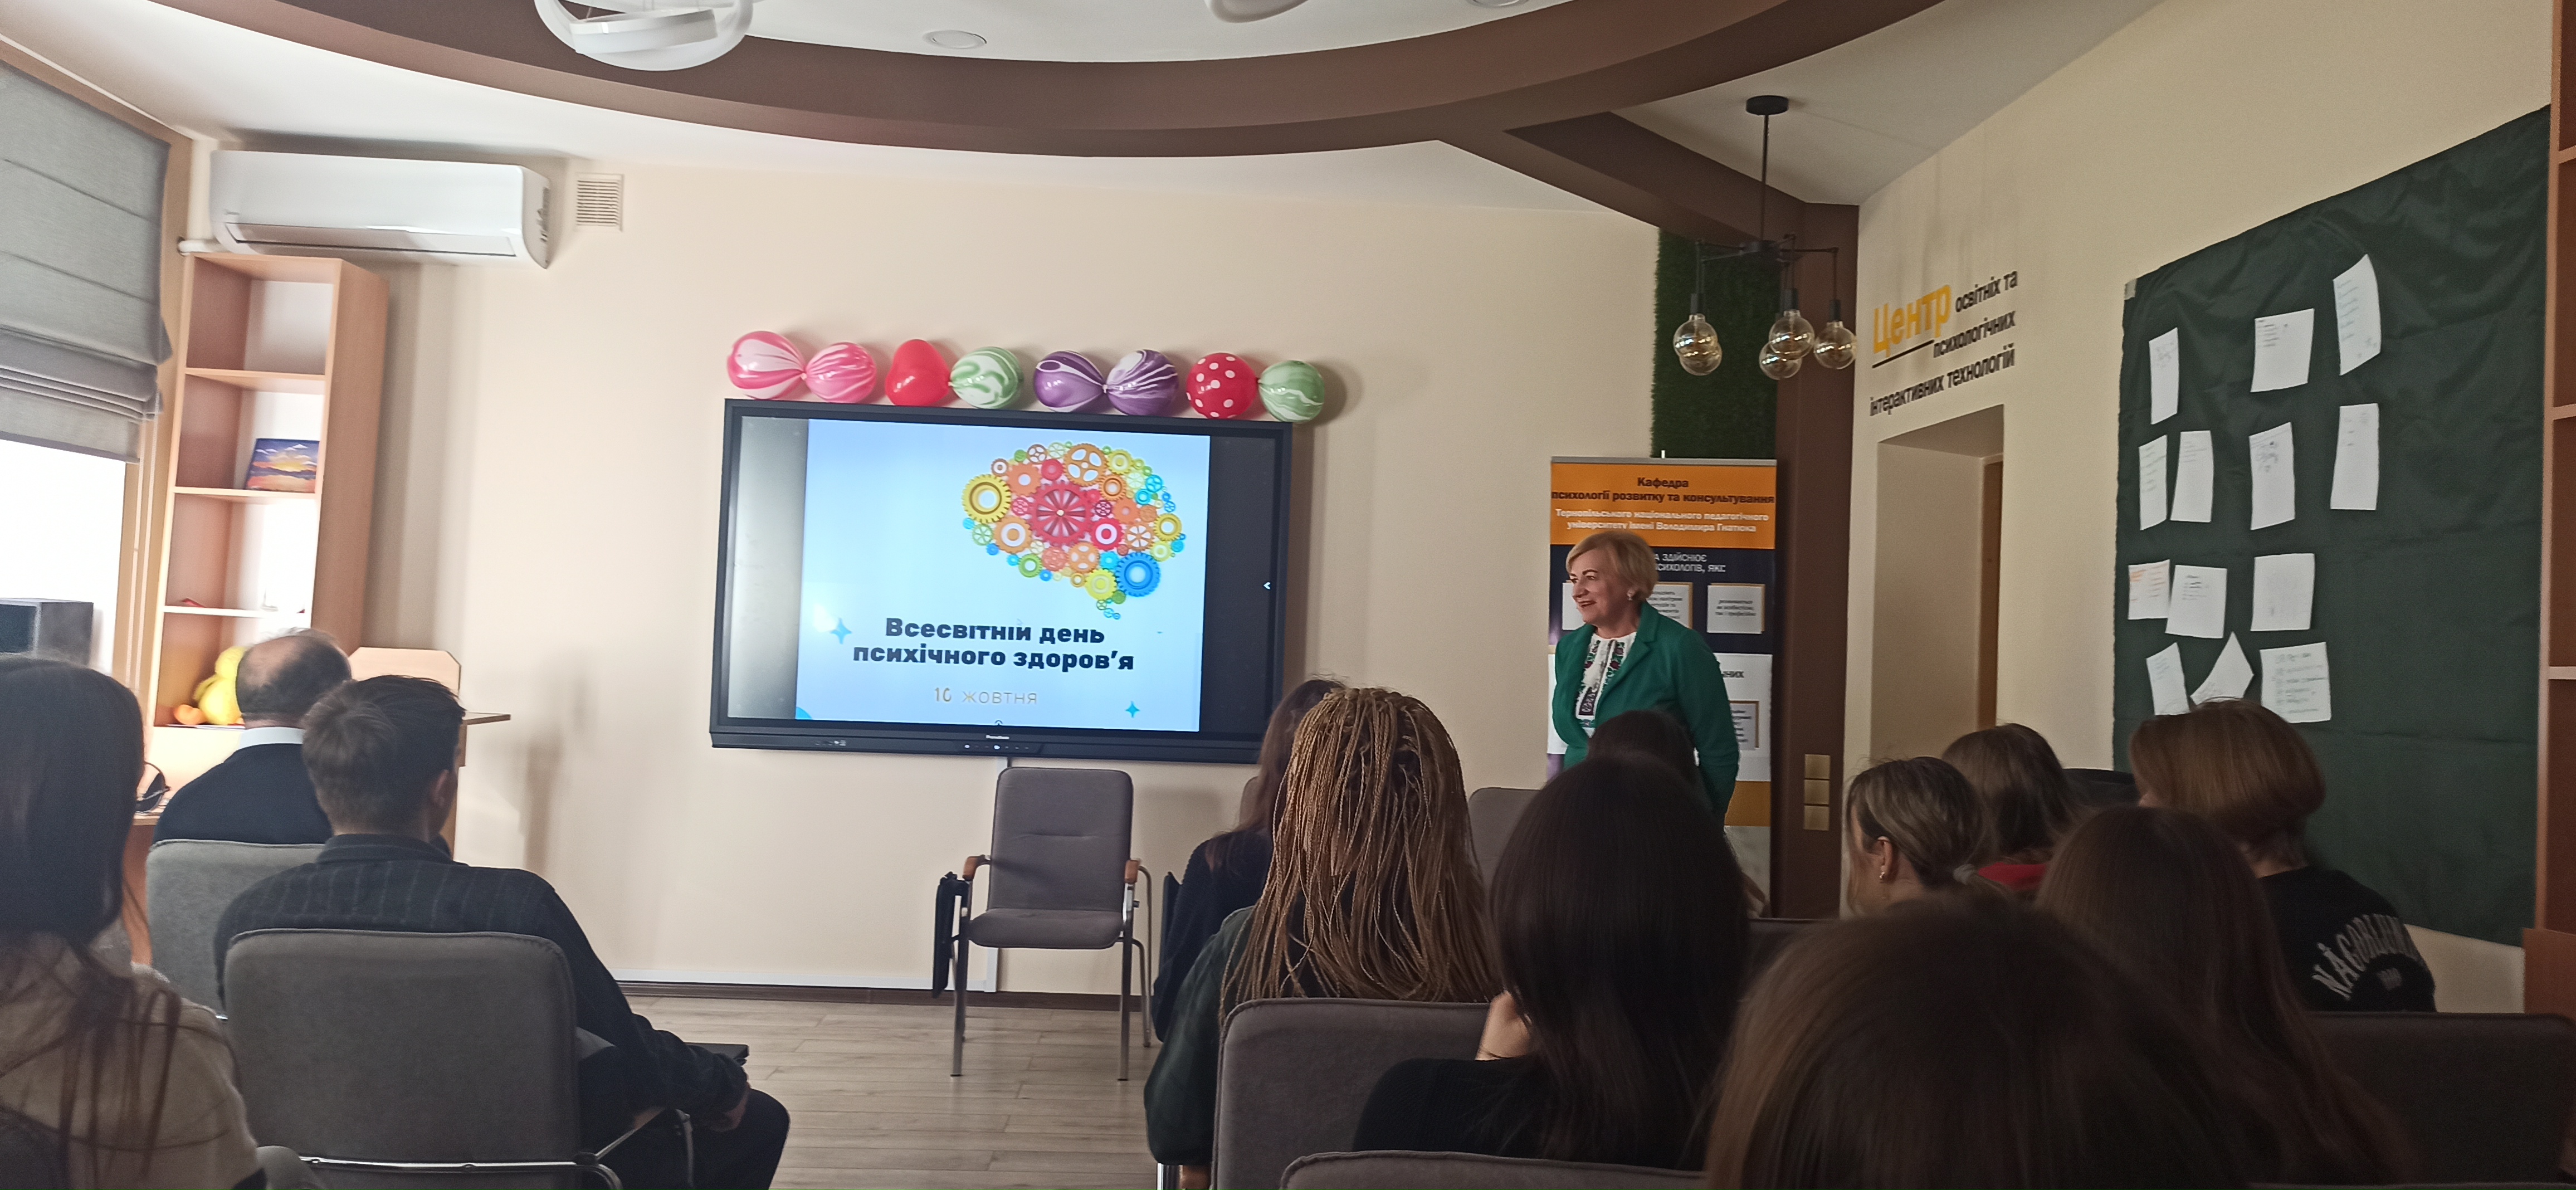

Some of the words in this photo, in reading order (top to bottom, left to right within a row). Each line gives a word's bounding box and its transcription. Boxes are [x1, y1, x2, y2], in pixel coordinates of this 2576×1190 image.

[1873, 284, 1951, 358] Центр
[1955, 276, 2002, 313] освітніх
[2003, 271, 2018, 291] та
[1933, 310, 2016, 358] психологічних
[1870, 375, 1945, 416] інтерактивних
[1946, 343, 2016, 388] технологій
[1637, 477, 1689, 489] Кафедра
[1551, 490, 1610, 500] психології
[1612, 492, 1665, 503] розвитку
[1683, 494, 1775, 505] консультування
[1704, 512, 1769, 521] педагогічного
[1656, 522, 1715, 533] Володимира
[1662, 552, 1707, 562] ЗДІЙСНЮЄ
[1039, 627, 1105, 644] день
[853, 643, 1006, 666] психічного
[1013, 650, 1134, 672] здоров’я
